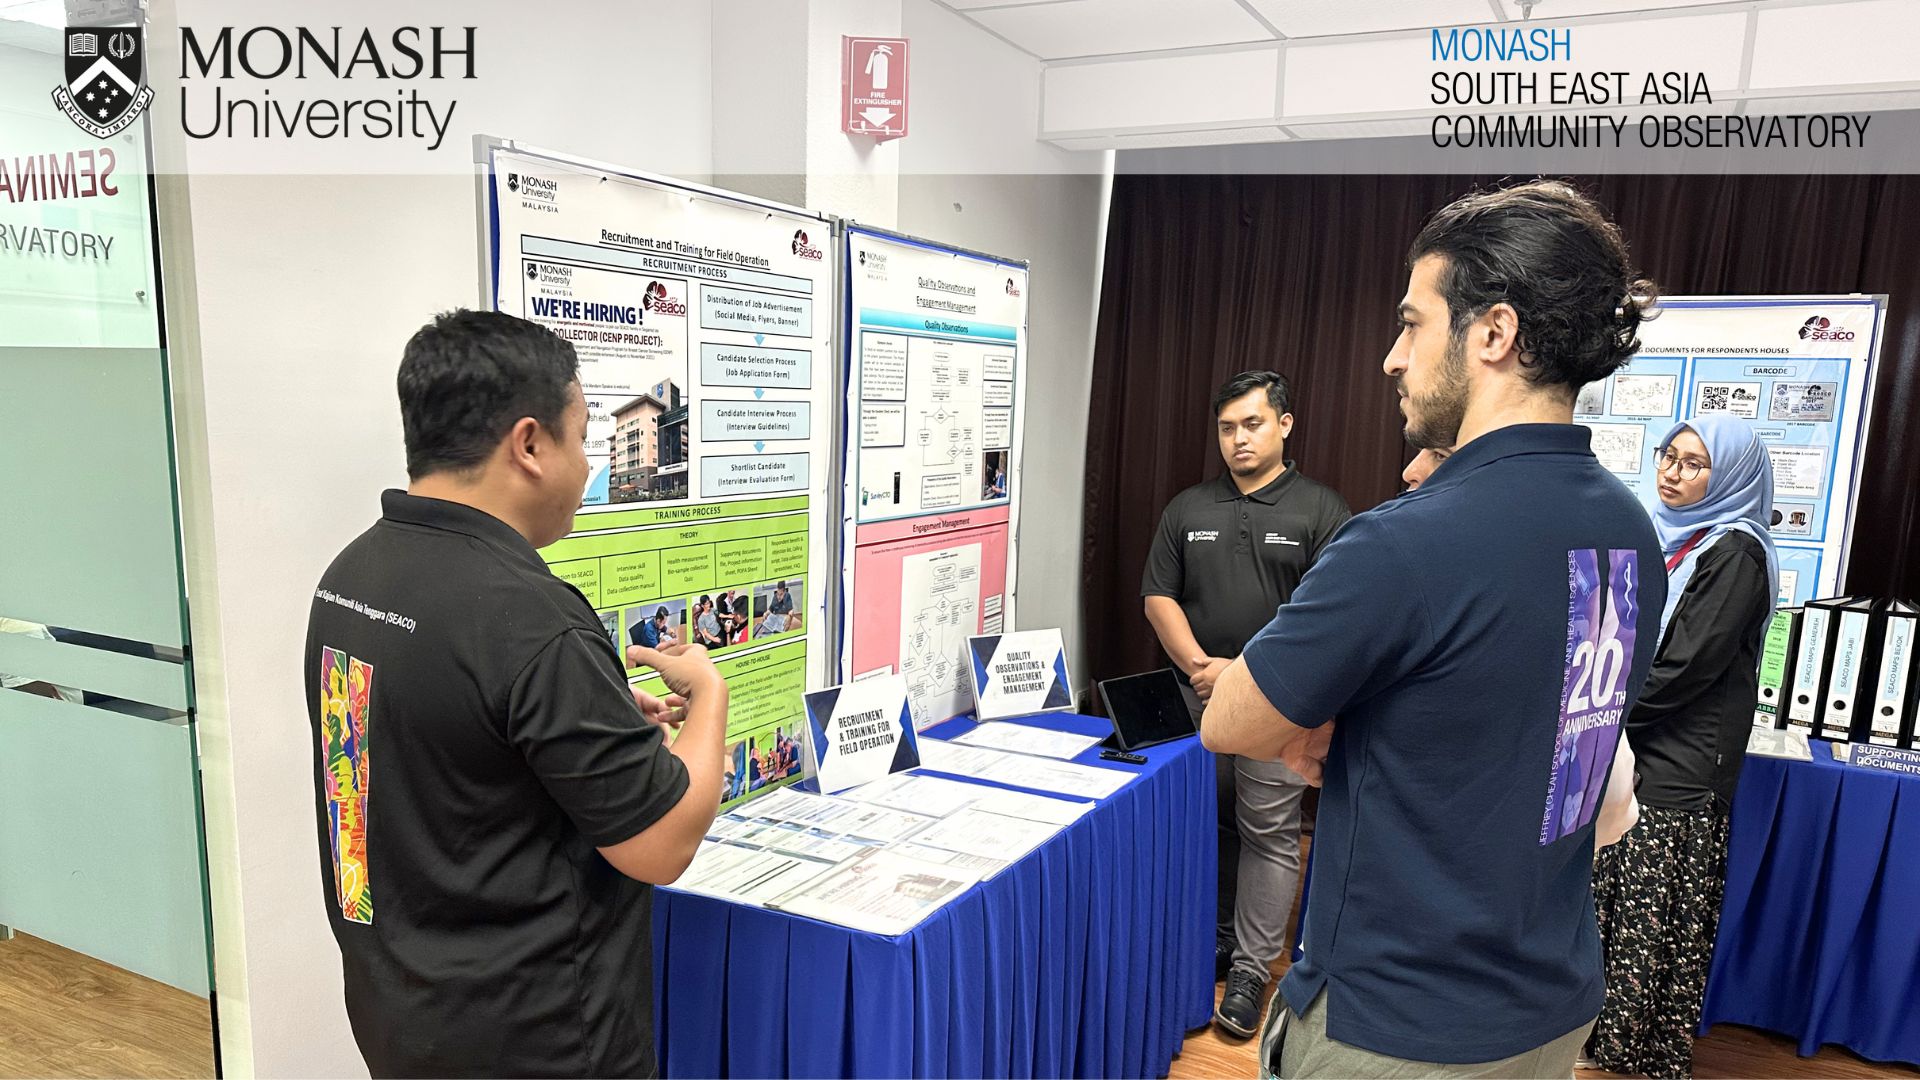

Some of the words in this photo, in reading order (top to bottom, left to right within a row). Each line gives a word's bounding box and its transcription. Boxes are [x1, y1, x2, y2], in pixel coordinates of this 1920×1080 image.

[853, 97, 902, 106] EXTINGUISHER
[521, 175, 557, 191] MONASH
[521, 185, 556, 201] University
[522, 201, 559, 213] MALAYSIA
[601, 229, 653, 248] Recruitment
[655, 240, 672, 251] and
[674, 241, 703, 259] Training
[704, 246, 715, 257] for
[716, 249, 734, 261] Field
[735, 252, 769, 267] Operation
[798, 249, 823, 260] seaco
[540, 264, 572, 277] MONASH
[642, 258, 697, 274] RECRUITMENT
[698, 265, 728, 279] PROCESS
[540, 274, 571, 286] University
[917, 276, 937, 290] Quality
[540, 287, 573, 297] MALAYSIA
[531, 296, 581, 320] WE'RE
[584, 302, 636, 325] HIRING
[653, 301, 686, 315] seaco
[706, 294, 744, 307] Distribution
[745, 298, 751, 308] of
[752, 299, 762, 309] Job
[763, 301, 803, 314] Advertisement
[715, 310, 735, 321] (Social
[736, 312, 757, 323] Media,
[758, 314, 776, 325] Flyers,
[777, 316, 799, 327] Banner)
[924, 319, 941, 331] Quality
[1811, 331, 1855, 341] seaco
[716, 354, 747, 363] Candidate
[748, 356, 774, 365] Selection
[775, 358, 797, 366] Process
[725, 368, 738, 377] (Job
[739, 370, 772, 379] Application
[773, 371, 790, 380] Form)
[1752, 367, 1788, 375] BARCODE
[716, 409, 746, 417] Candidate
[747, 409, 775, 418] Interview
[776, 409, 797, 418] Process
[726, 423, 756, 431] (Interview
[757, 422, 790, 431] Guidelines)
[731, 463, 756, 472] Shortlist
[757, 462, 786, 471] Candidate
[718, 478, 748, 487] (Interview
[749, 476, 780, 485] Evaluation
[780, 474, 796, 483] Form)
[654, 508, 691, 520] TRAINING
[692, 505, 721, 516] PROCESS
[912, 520, 941, 533] Engagement
[941, 517, 970, 530] Management
[679, 531, 699, 540] THEORY
[1567, 550, 1577, 600] SCIENCES
[385, 611, 417, 634] (SEACO)
[1566, 601, 1576, 640] HEALTH
[1006, 651, 1031, 662] QUALITY
[1564, 640, 1573, 663] AND
[995, 661, 1040, 674] OBSERVATIONS
[1803, 663, 1813, 683] SEACO
[1002, 671, 1042, 684] ENGAGEMENT
[1566, 638, 1624, 715] 20
[1614, 691, 1627, 706] TH
[1887, 673, 1897, 694] SEACO
[1003, 681, 1046, 695] MANAGEMENT
[1560, 664, 1572, 712] MEDICINE
[838, 708, 884, 729] RECRUITMENT
[1557, 712, 1565, 727] OF
[1562, 708, 1624, 737] ANNIVERSARY
[839, 732, 845, 742] &
[845, 724, 877, 741] TRAINING
[877, 720, 891, 733] FOR
[838, 741, 858, 756] FIELD
[859, 733, 895, 751] OPERATION
[1551, 728, 1562, 770] SCHOOL
[1857, 745, 1920, 763] SUPPORTIN
[1545, 772, 1558, 806] CHEAH
[1539, 803, 1553, 846] JEFFREY
